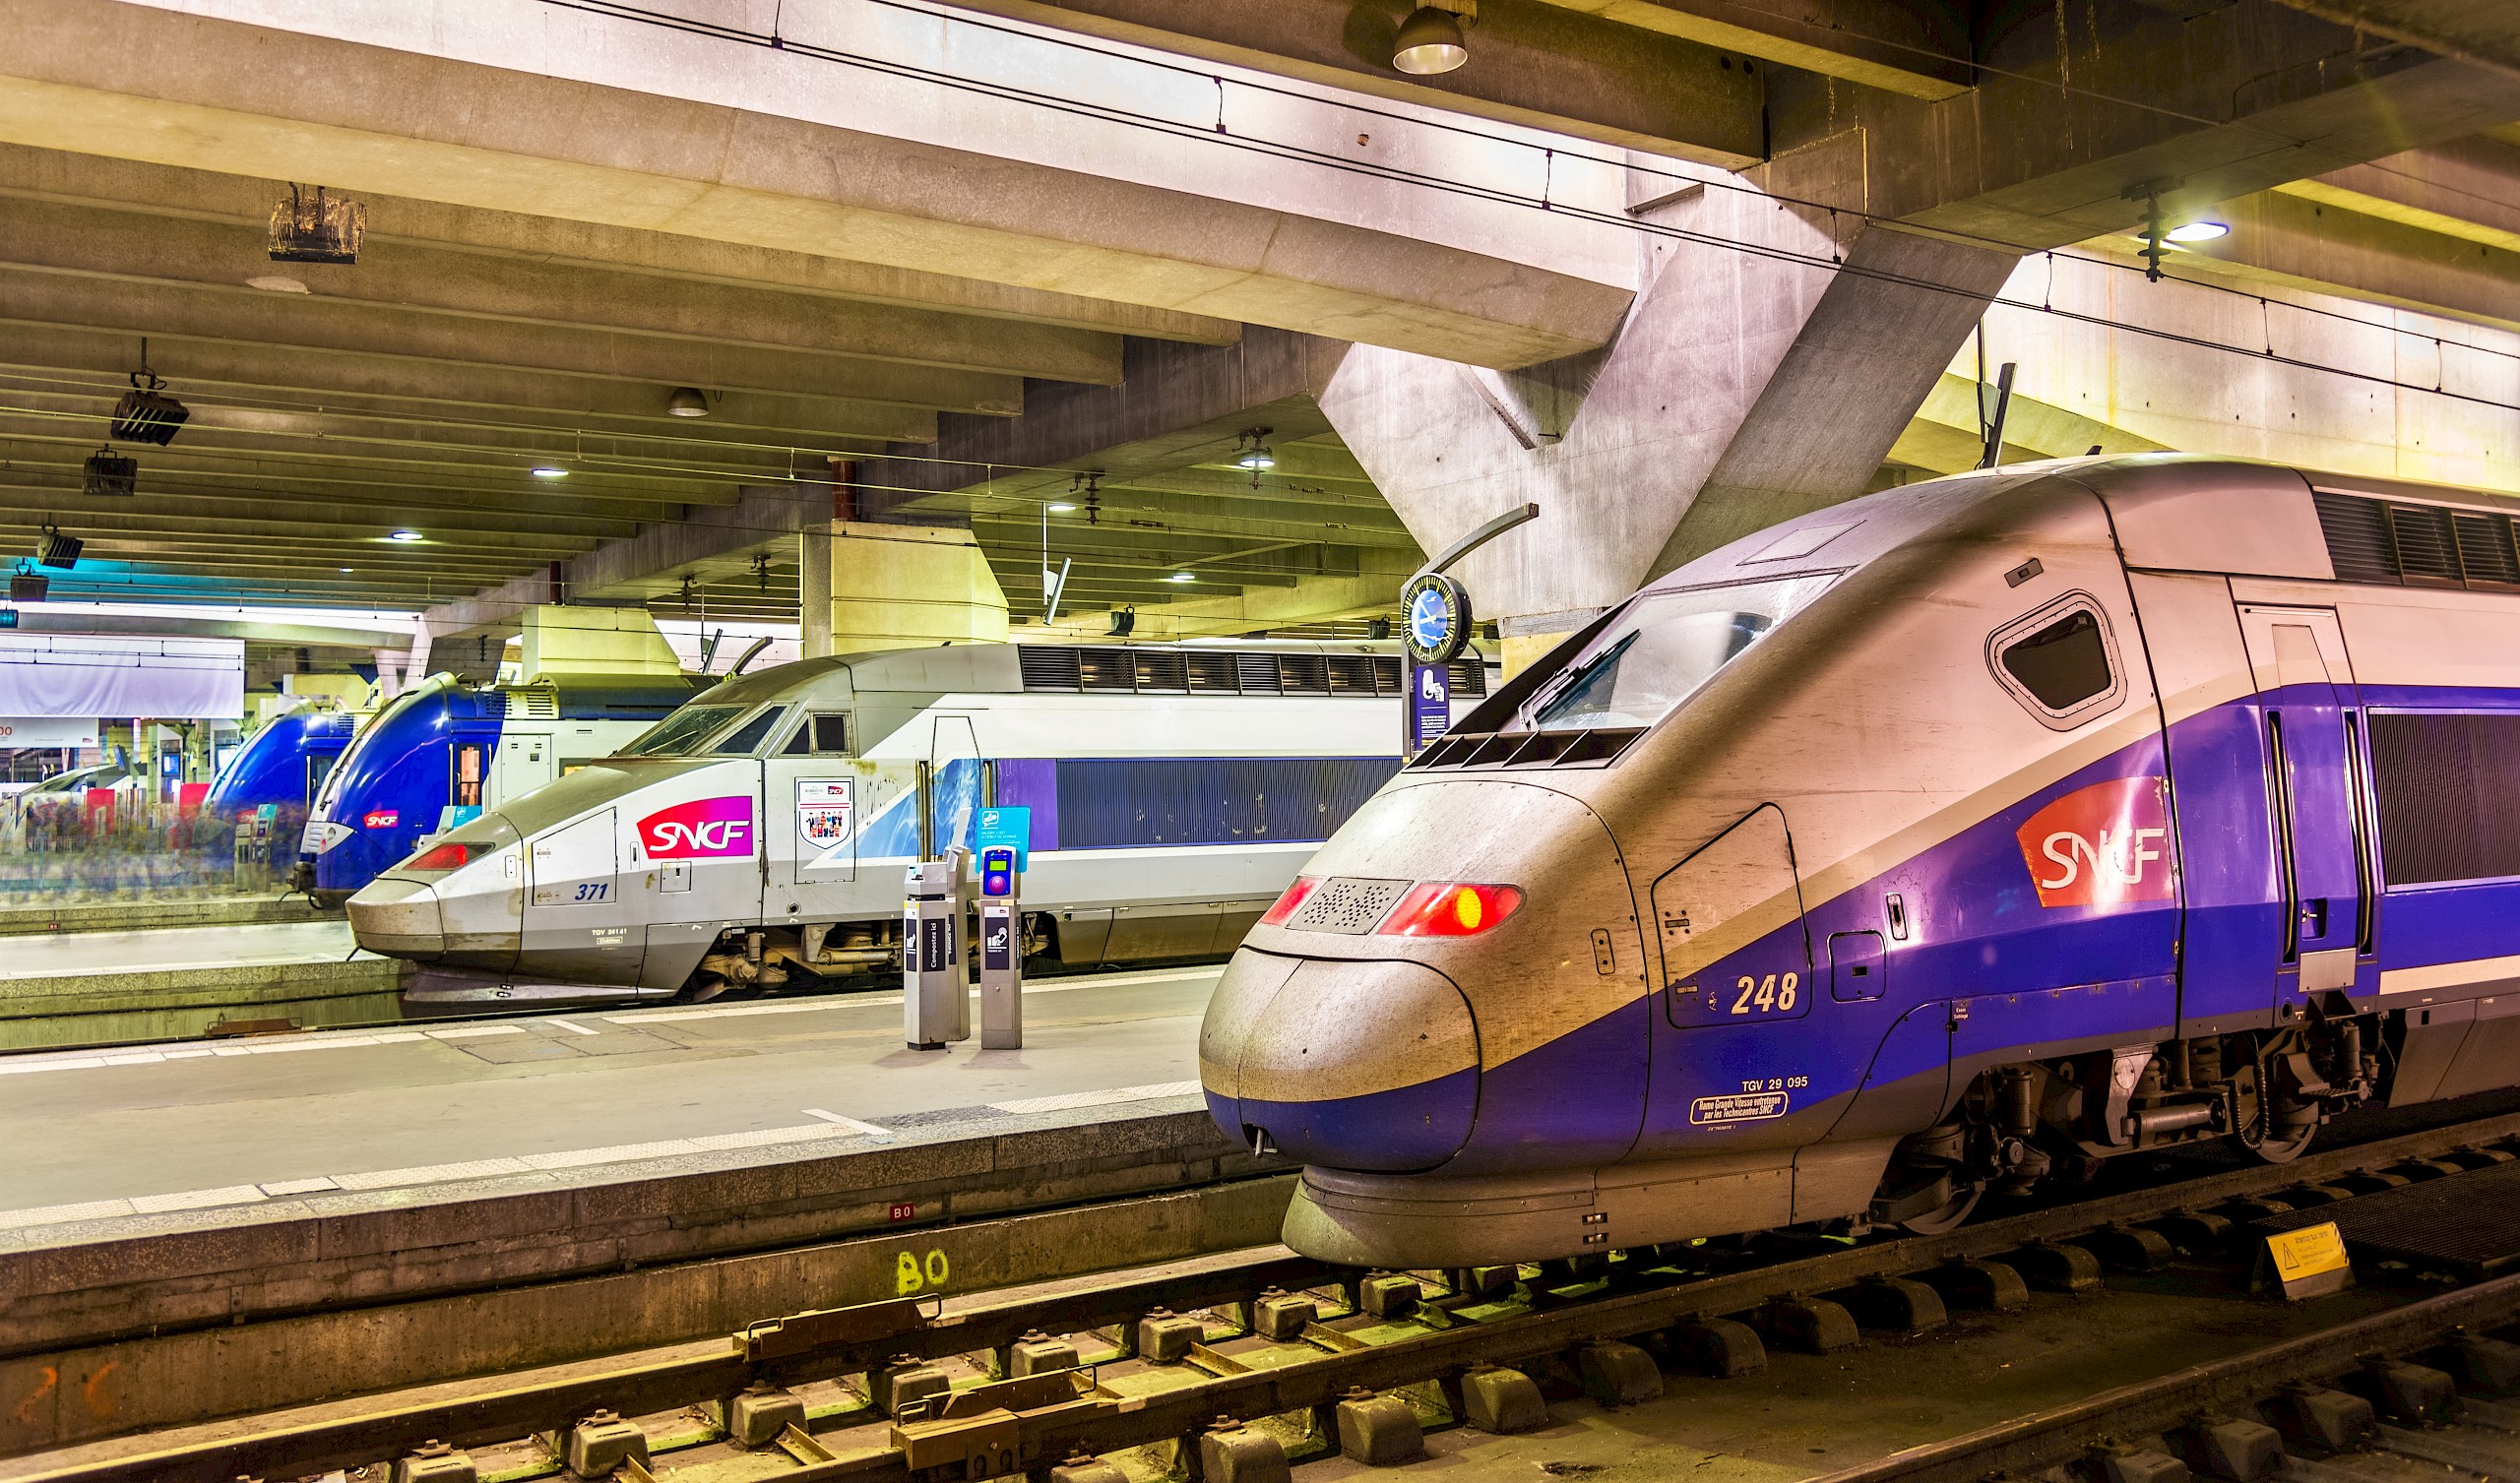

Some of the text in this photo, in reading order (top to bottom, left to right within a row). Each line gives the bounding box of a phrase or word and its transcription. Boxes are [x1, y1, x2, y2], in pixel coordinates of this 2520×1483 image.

[367, 816, 398, 827] SNCF
[649, 820, 750, 851] SNCF
[2041, 828, 2165, 890] SNCF
[575, 883, 608, 900] 371
[1731, 971, 1798, 1015] 248
[1741, 1076, 1808, 1092] TGV 29 095
[1699, 1100, 1714, 1111] Rame
[1715, 1098, 1733, 1110] Grande
[1734, 1097, 1753, 1109] Vitesse
[1704, 1111, 1714, 1122] par
[1714, 1109, 1723, 1119] les
[1759, 1105, 1775, 1115] SNCF
